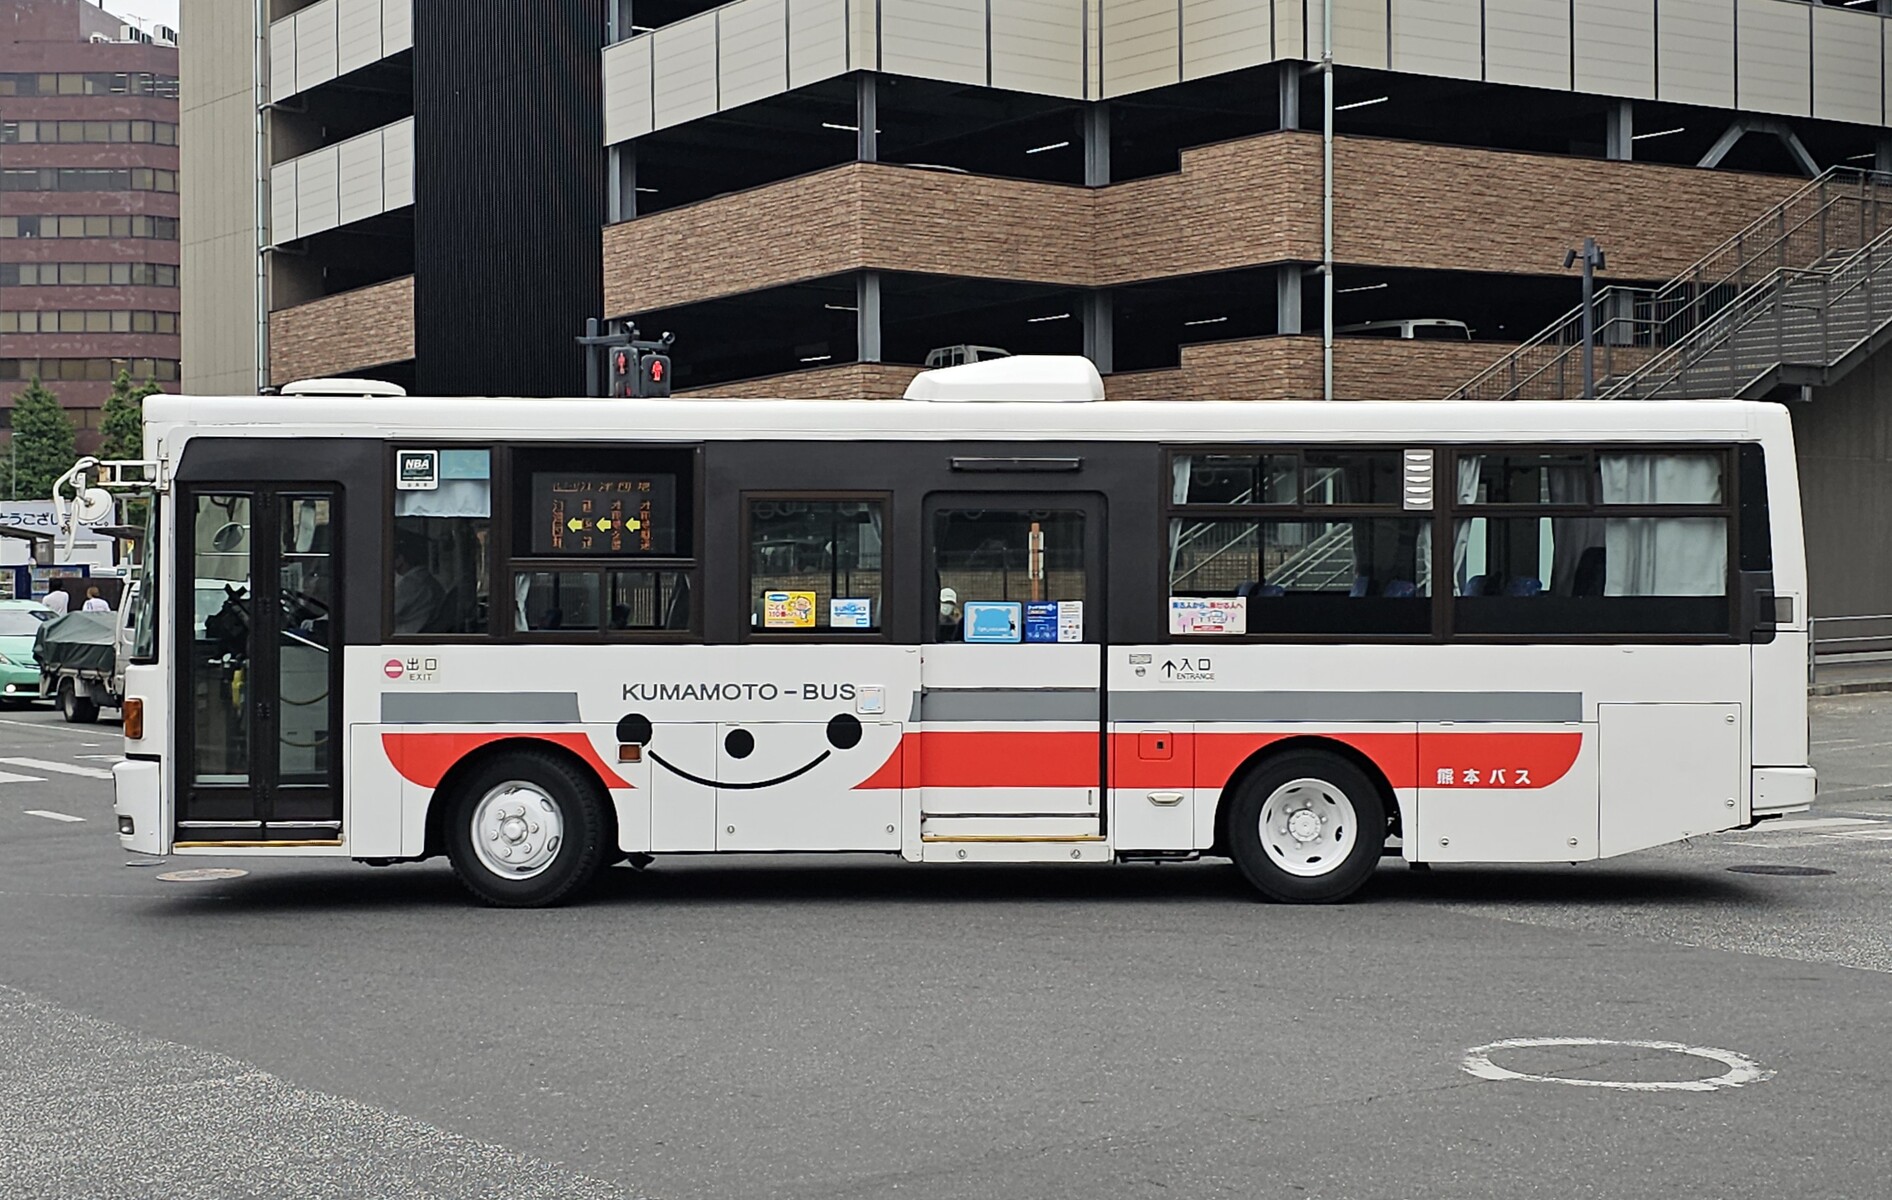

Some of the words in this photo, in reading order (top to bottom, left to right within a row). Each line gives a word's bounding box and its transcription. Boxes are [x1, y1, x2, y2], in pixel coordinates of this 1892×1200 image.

[406, 458, 430, 470] NBA
[406, 657, 437, 671] 出口
[1180, 658, 1211, 671] 入口
[409, 673, 433, 681] EXIT
[1176, 672, 1216, 680] ENTRANCE
[1436, 768, 1532, 785] 熊本バス
